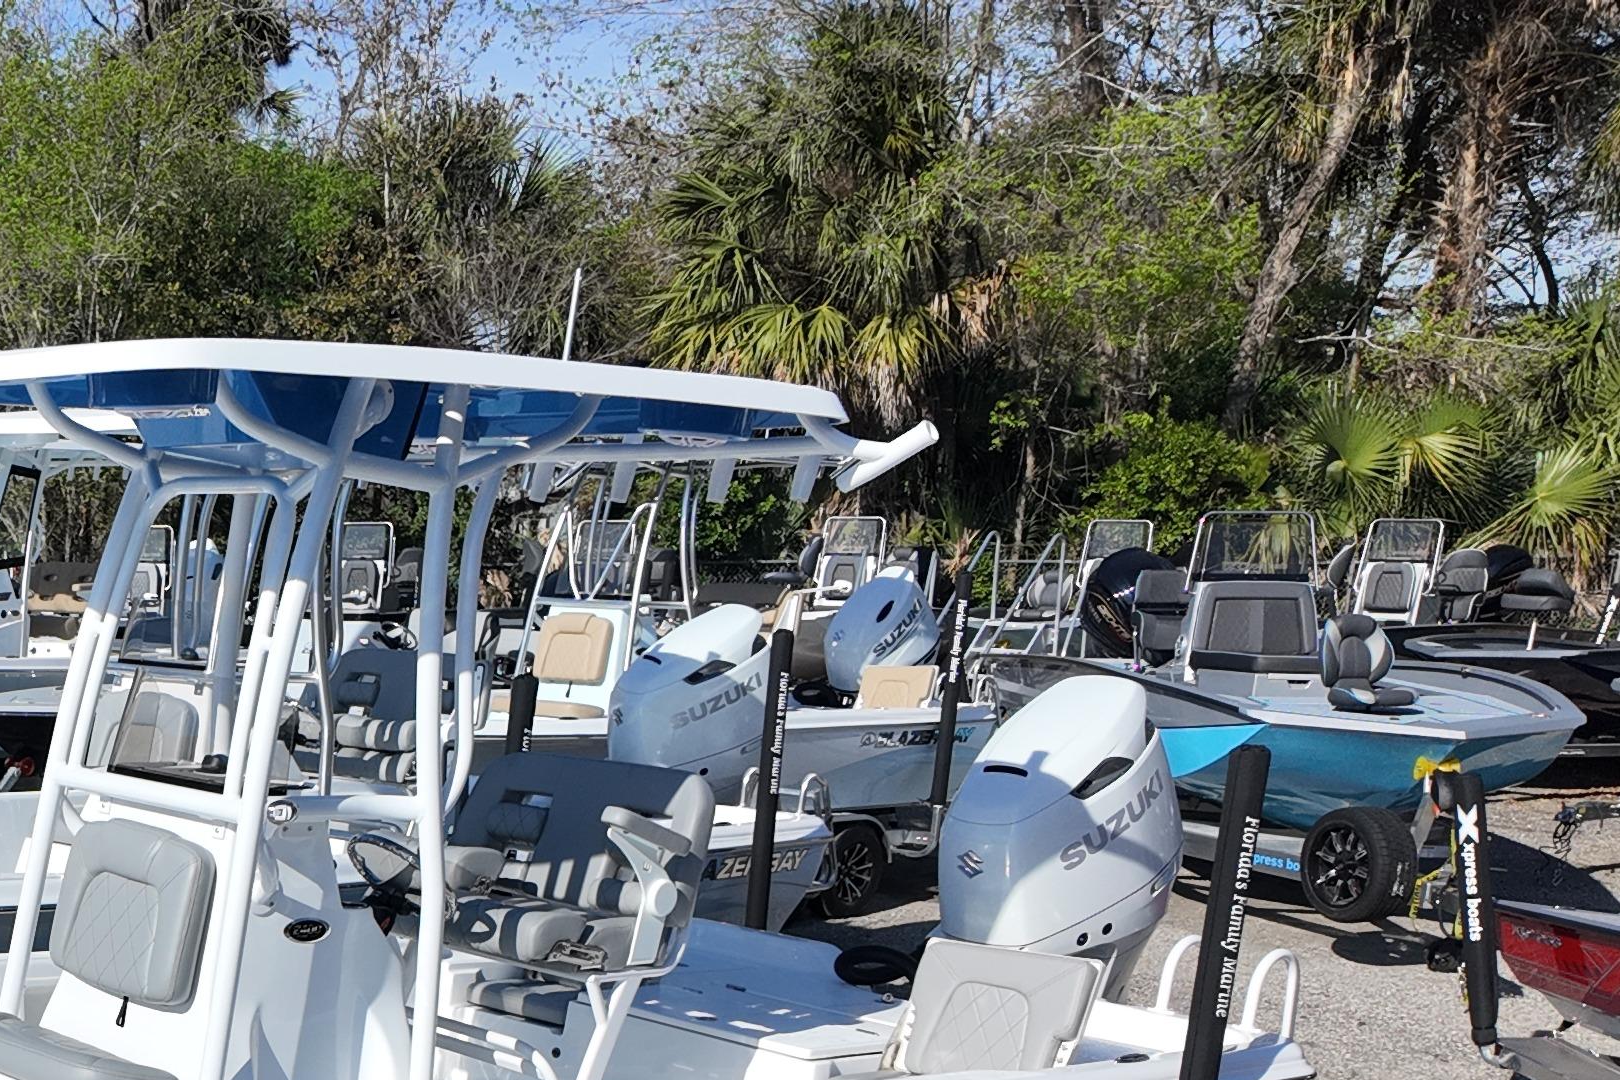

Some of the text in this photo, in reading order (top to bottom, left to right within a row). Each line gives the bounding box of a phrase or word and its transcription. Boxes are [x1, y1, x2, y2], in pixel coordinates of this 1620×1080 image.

[873, 598, 923, 657] SUZUKI
[669, 671, 763, 731] SUZUKI
[1059, 768, 1164, 872] SUZUKI
[700, 856, 752, 881] AZE
[1252, 853, 1284, 869] press
[1461, 842, 1478, 896] xpress
[1215, 815, 1261, 1019] Florida's Family Marine
[1466, 898, 1484, 942] boats
